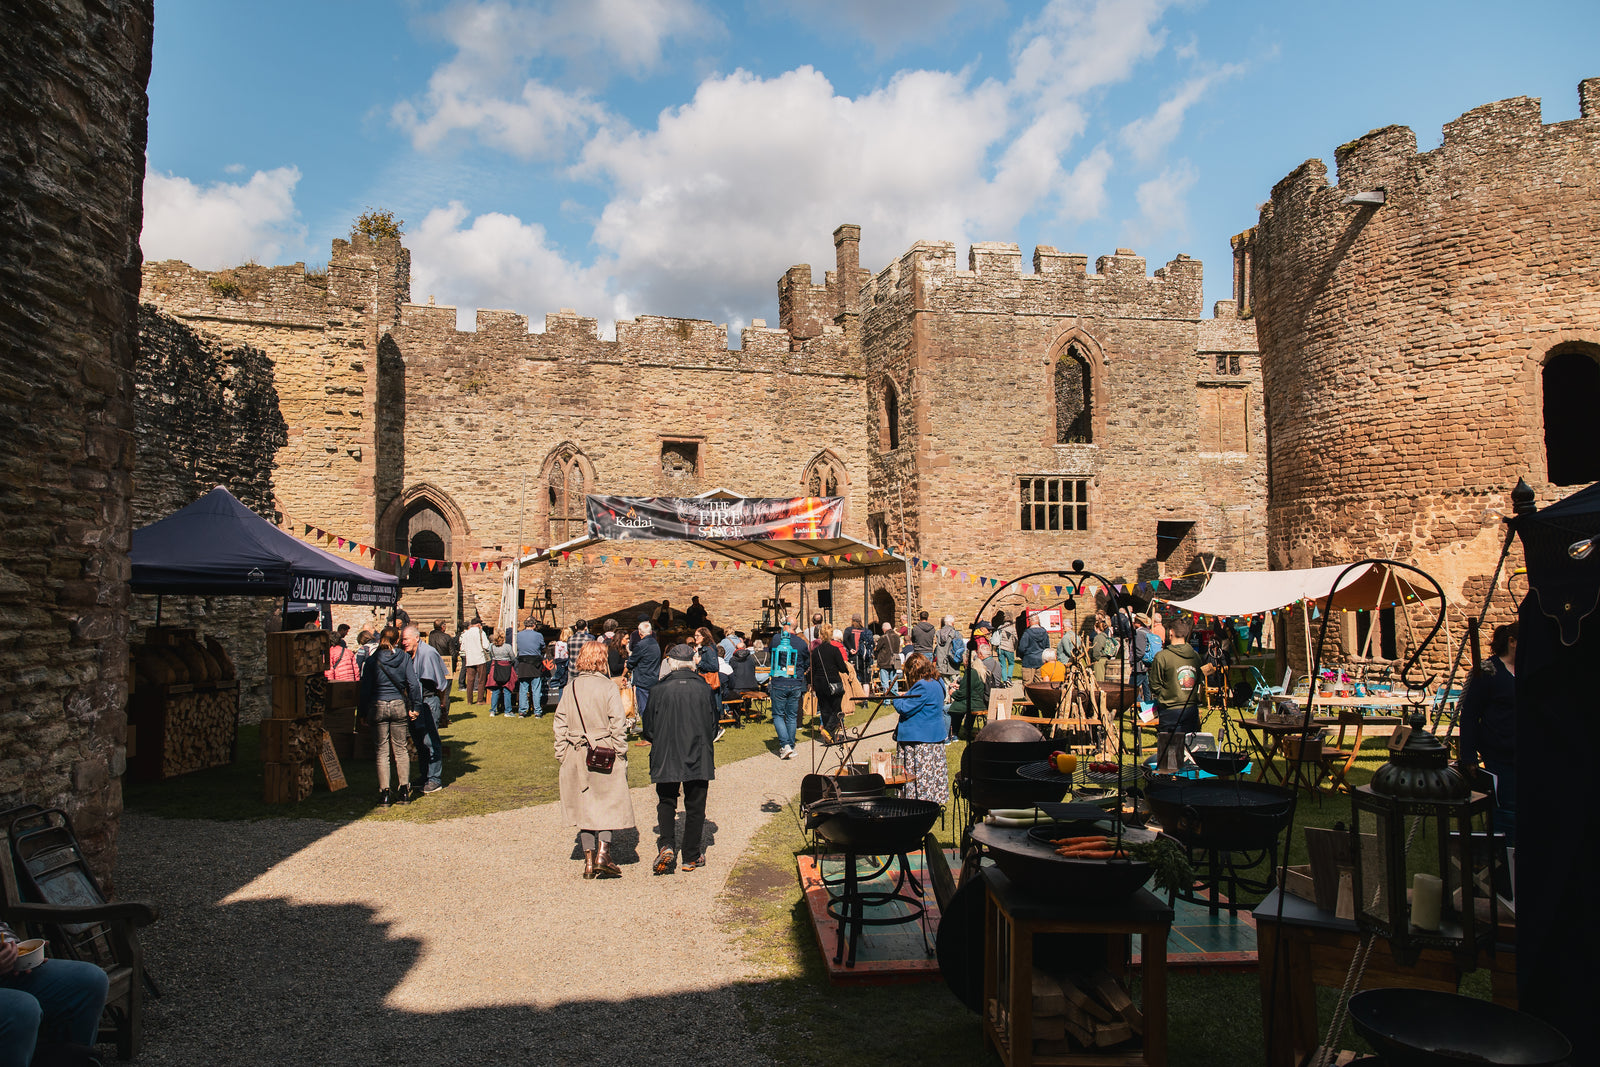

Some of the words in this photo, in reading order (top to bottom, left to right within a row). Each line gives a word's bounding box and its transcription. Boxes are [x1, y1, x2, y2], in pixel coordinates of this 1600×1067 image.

[707, 501, 730, 511] THE
[615, 516, 653, 528] Kadai
[699, 510, 743, 526] FIRE
[698, 525, 744, 538] STAGE
[300, 577, 326, 600] LOVE
[327, 580, 349, 601] LOGS
